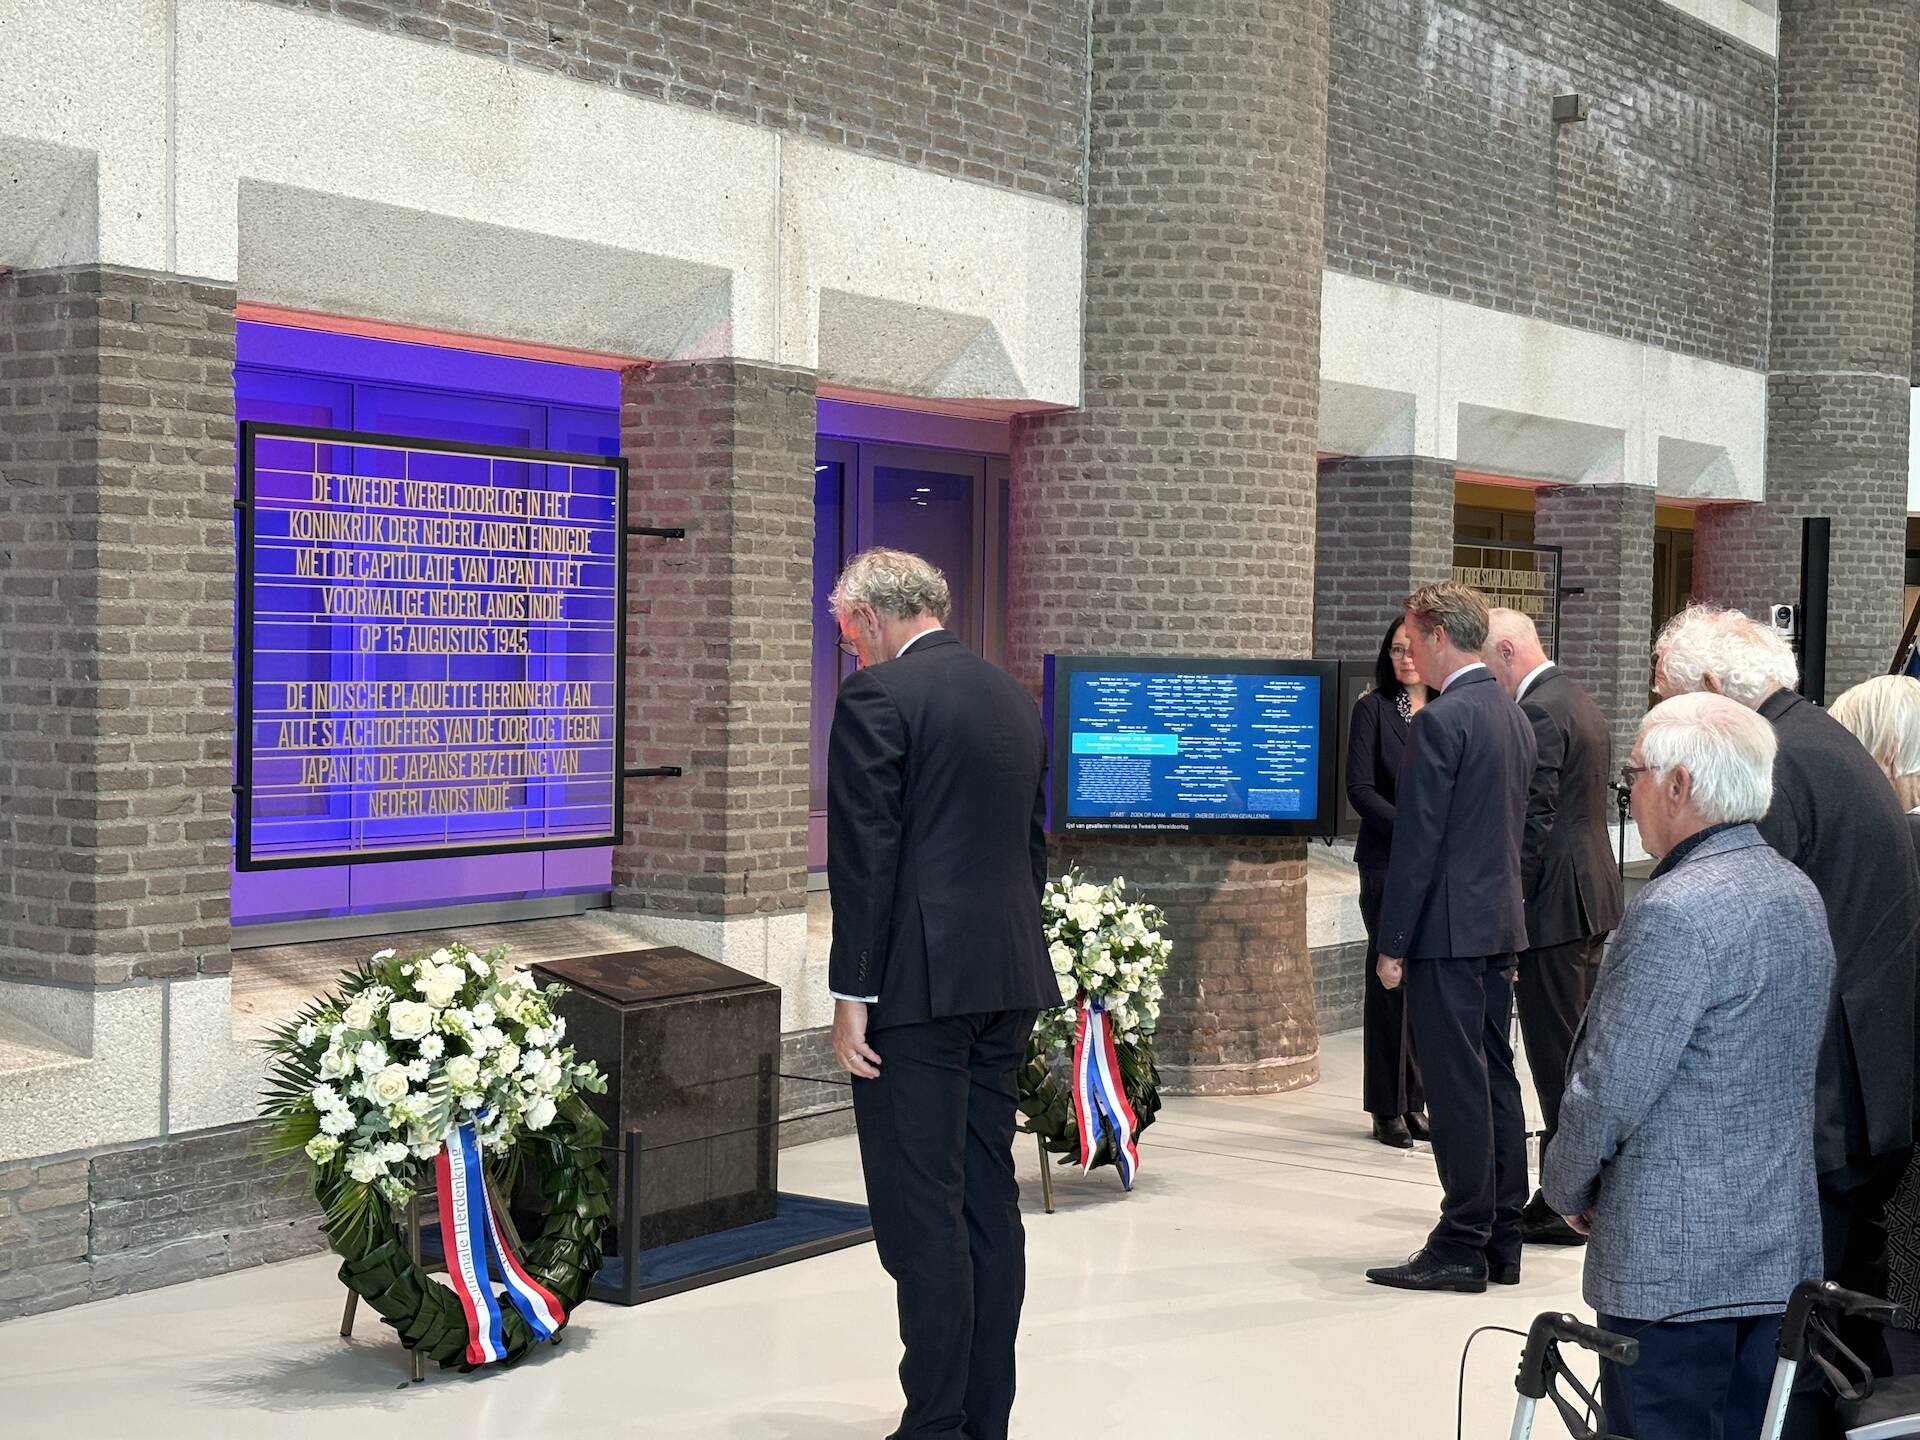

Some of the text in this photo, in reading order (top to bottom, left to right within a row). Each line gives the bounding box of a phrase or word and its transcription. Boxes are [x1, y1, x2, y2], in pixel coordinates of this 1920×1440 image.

[312, 473, 572, 519] DE TWEEDE WERELDOORLOG IN HET
[289, 510, 592, 554] KONINKRIJK DER NEDERLANDEN EINDIGDE
[296, 549, 583, 587] MET DE CAPITULATIE VAN JAPAN IN HET
[322, 587, 564, 620] VOORMALIGE NEDERLANDS INDIË
[360, 625, 531, 653] OP 15 AUGUSTUS 1945.
[287, 682, 591, 710] DE INDISCHE PLAQUETTE HERINNERT AAN
[278, 715, 600, 748] ALLE SLACHTOFFERS VAN DE OORLOG TEGEN
[299, 750, 579, 785] JAPAN EN DE JAPANSE BEZETTING VAN
[368, 781, 512, 817] NEDERLANDS INDIË.
[450, 1148, 485, 1308] Nationale Herdenking
